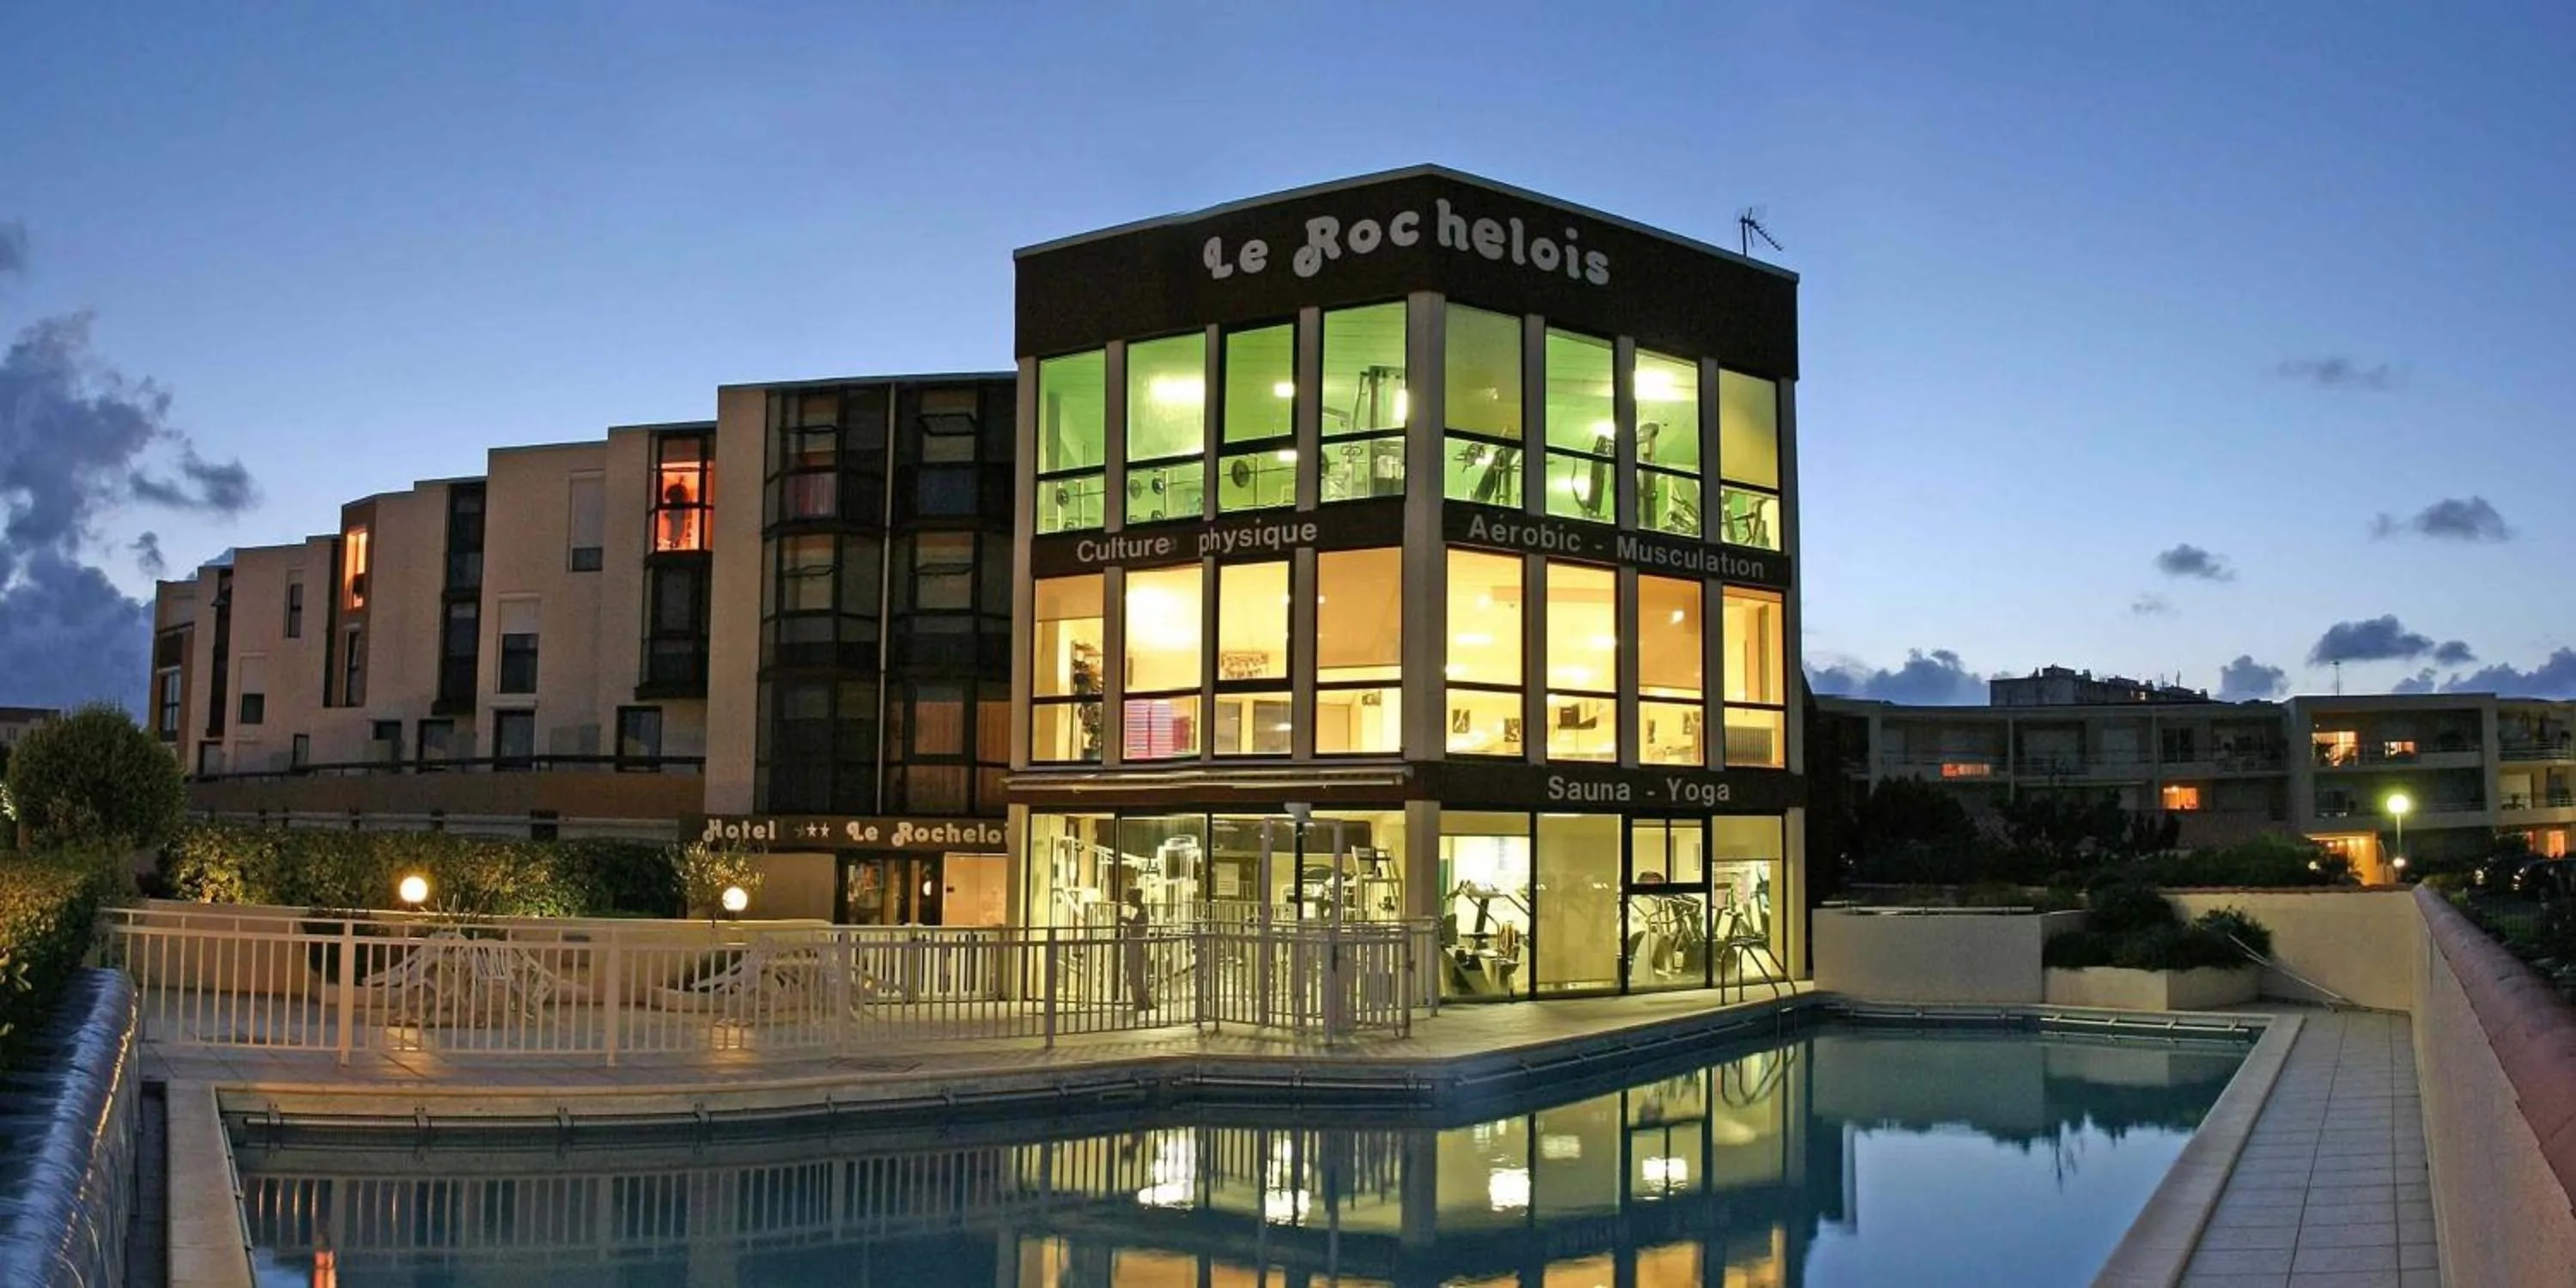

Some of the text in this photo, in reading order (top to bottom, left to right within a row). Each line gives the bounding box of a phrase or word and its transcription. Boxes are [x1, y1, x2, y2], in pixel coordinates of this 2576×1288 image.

[1202, 197, 1610, 286] Le Rochelois
[1076, 518, 1319, 563] Culture physique
[1467, 513, 1582, 553] Aérobic
[1616, 534, 1765, 579] Musculation
[1547, 775, 1631, 801] Sauna
[1666, 776, 1731, 806] Yoga
[702, 817, 776, 843] Hotel
[846, 820, 879, 842] Le
